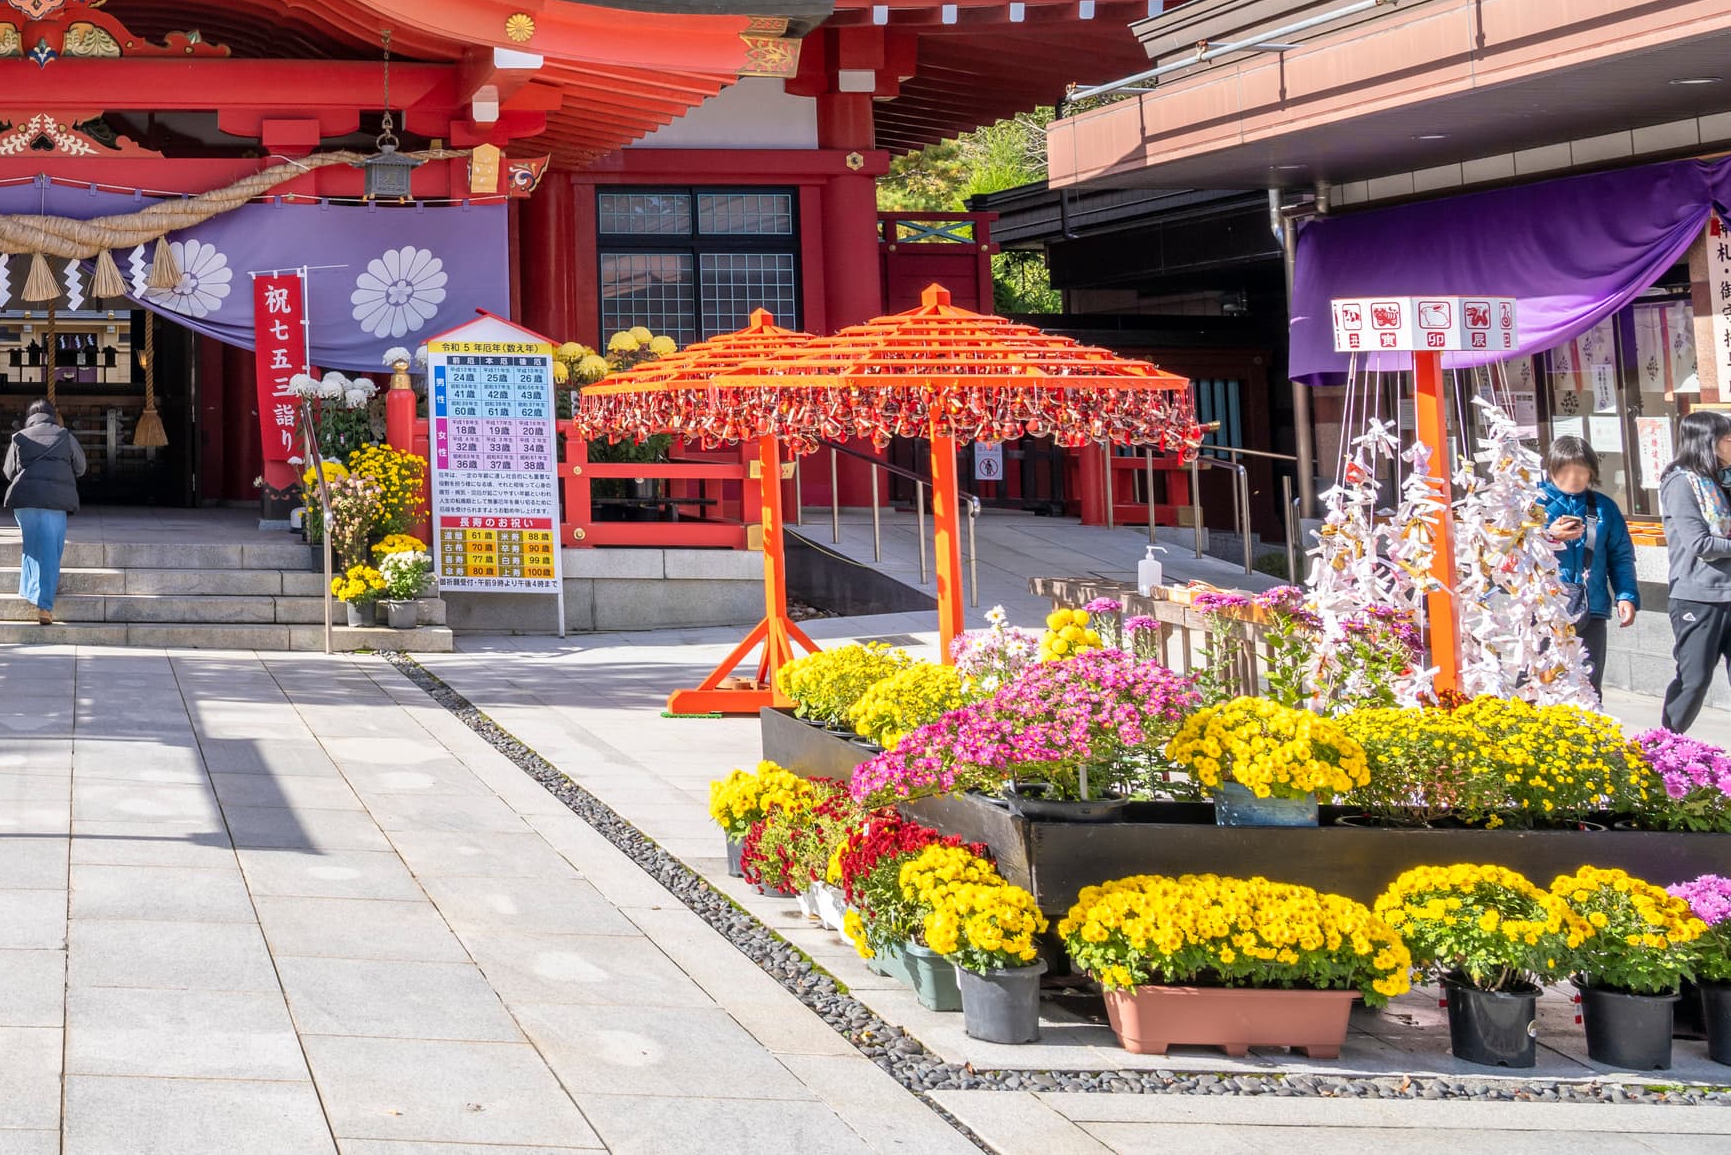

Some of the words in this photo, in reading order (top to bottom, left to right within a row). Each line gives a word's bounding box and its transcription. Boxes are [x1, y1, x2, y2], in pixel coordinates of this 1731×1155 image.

[1380, 333, 1396, 347] 寅
[1428, 333, 1444, 347] 卯
[1472, 333, 1486, 346] 辰
[264, 285, 296, 453] 祝七五三詣り
[487, 374, 508, 382] 25歳
[436, 378, 444, 404] 男性
[488, 391, 508, 399] 42歳
[488, 408, 509, 416] 61歳
[522, 408, 542, 416] 62歳
[456, 427, 476, 435] 18歳
[490, 427, 509, 435] 19歳
[523, 427, 543, 435] 20歳
[438, 431, 446, 457] 女性
[456, 443, 476, 451] 32歳
[490, 444, 510, 452] 33歳
[524, 444, 544, 452] 34歳
[457, 461, 477, 469] 36歳
[490, 461, 511, 469] 37歳
[524, 462, 545, 470] 38歳
[460, 517, 533, 527] 長寿のお祝い
[501, 533, 520, 541] 米寿
[528, 533, 549, 541] 88歳
[472, 544, 493, 552] 70歳
[502, 556, 520, 564] 白寿
[529, 556, 550, 564] 99歳
[473, 567, 494, 575] 80歳
[502, 568, 521, 577] 上寿
